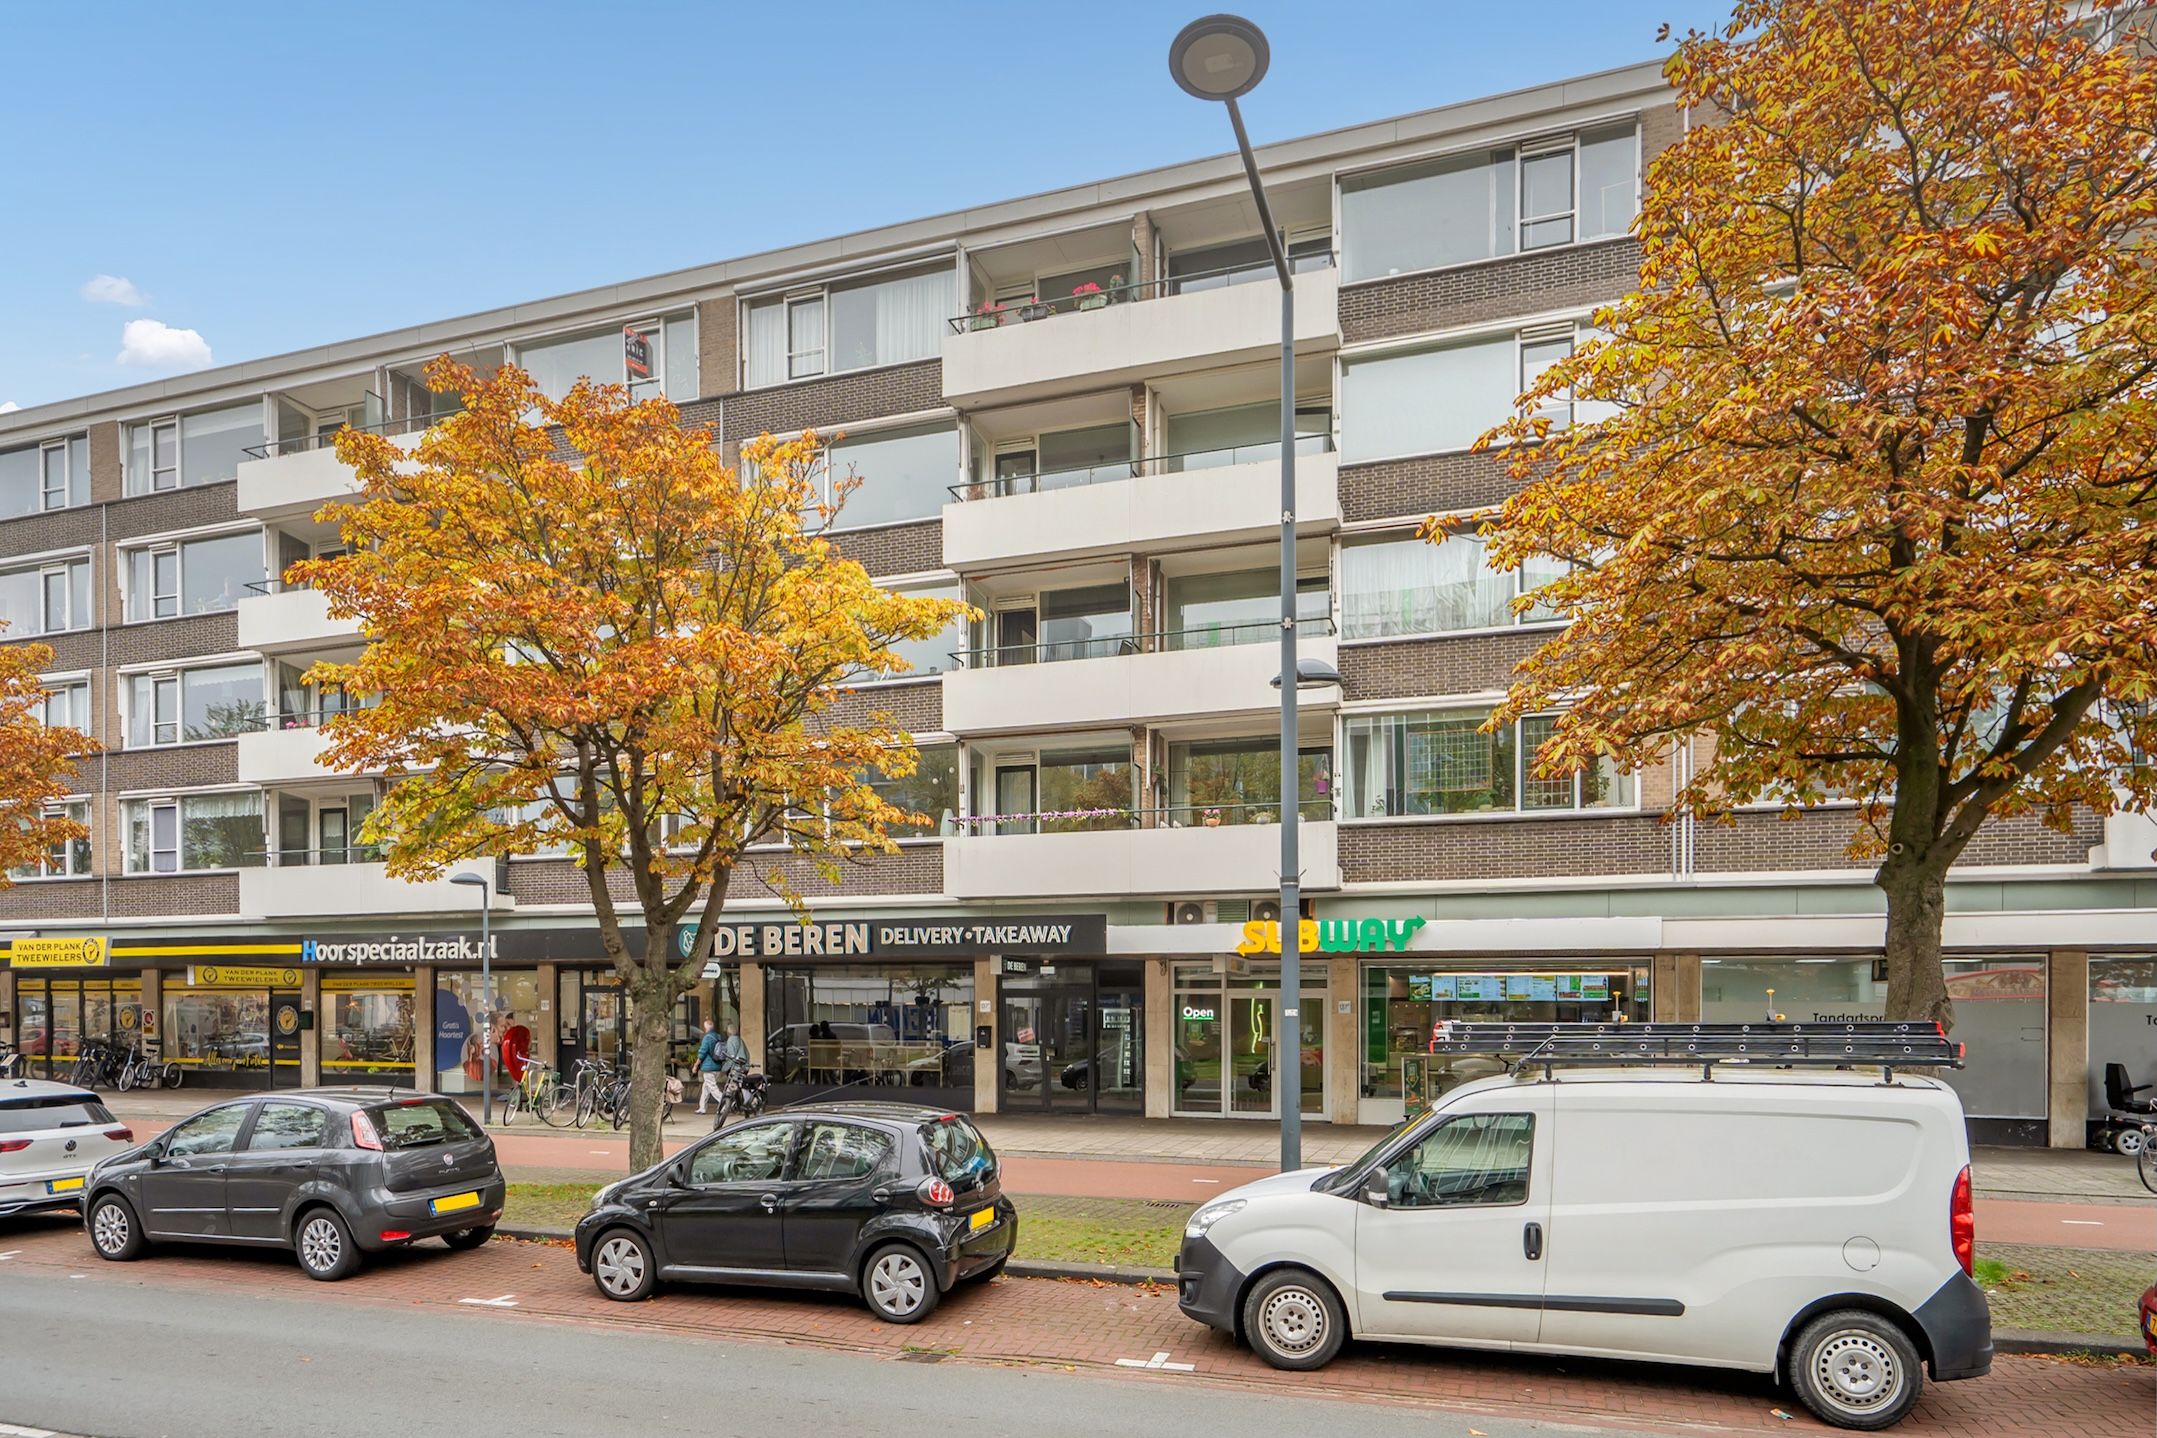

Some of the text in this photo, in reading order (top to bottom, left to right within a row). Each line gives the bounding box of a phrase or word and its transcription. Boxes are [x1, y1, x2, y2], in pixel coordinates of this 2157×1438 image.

[714, 923, 869, 956] DE BEREN
[880, 925, 1072, 945] DELIVERY TAKEAWAY
[1236, 915, 1426, 956] SUBWAY
[18, 942, 81, 951] VAN DER PLANK
[16, 953, 82, 963] TWEEWIELERS
[1183, 1006, 1214, 1019] Open
[1813, 1013, 1885, 1022] Tandartspr
[438, 1031, 464, 1039] Hoortest
